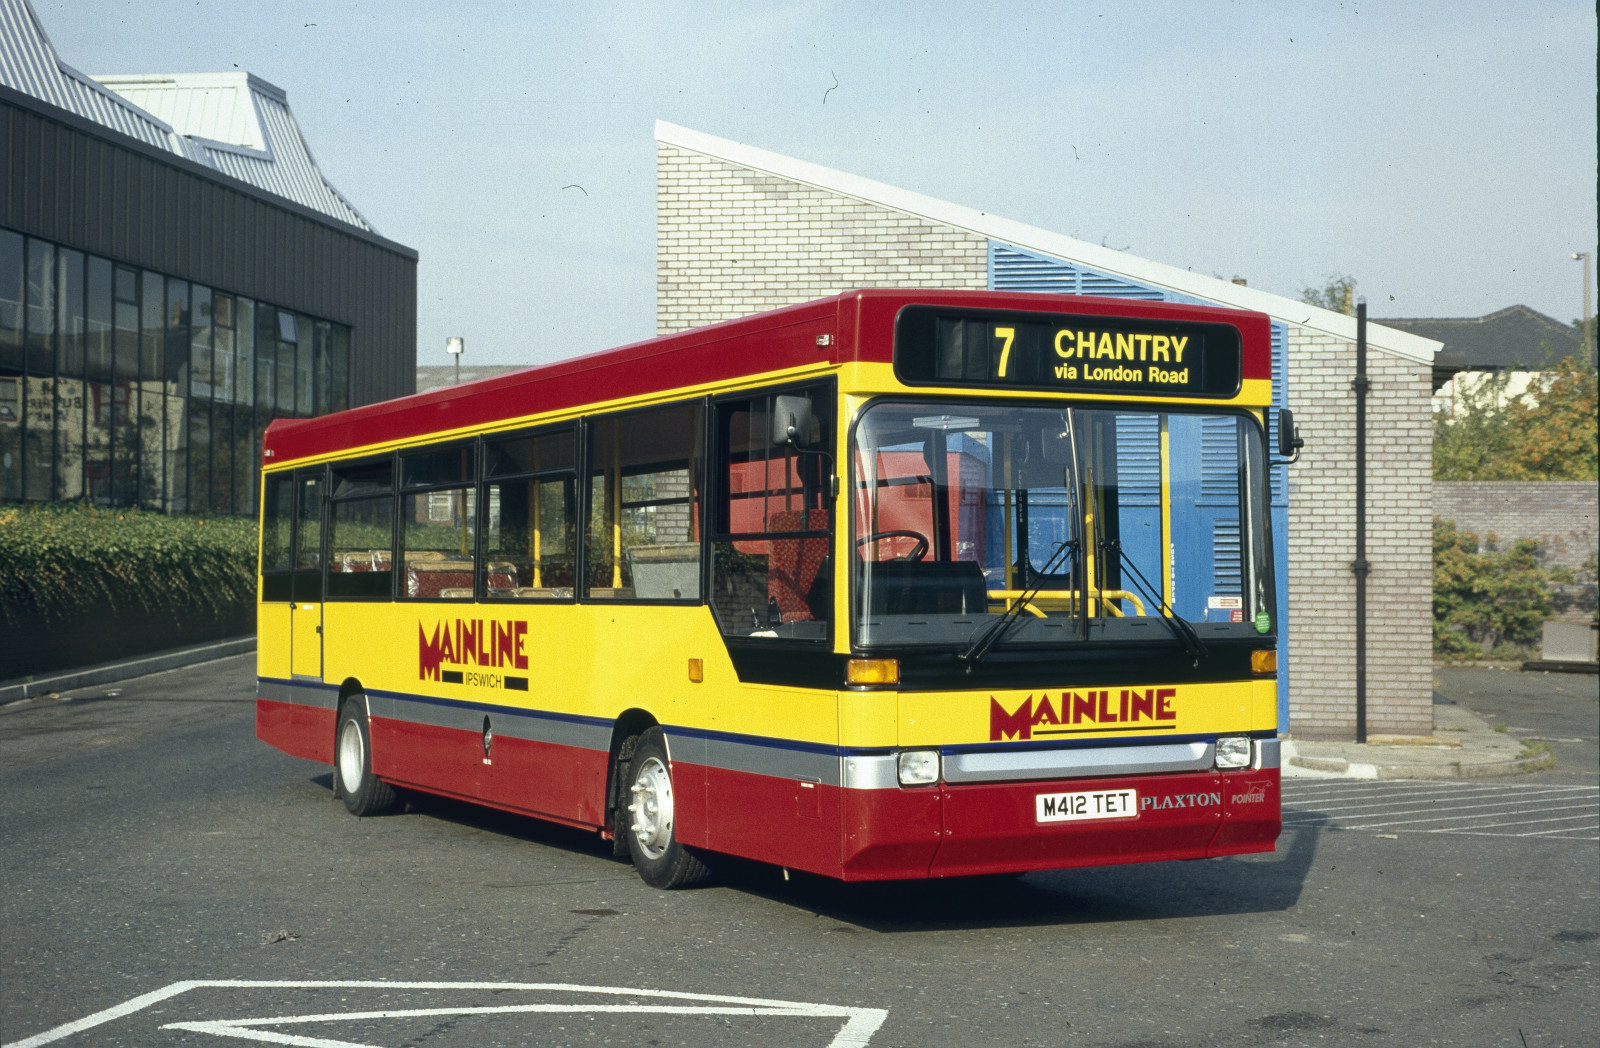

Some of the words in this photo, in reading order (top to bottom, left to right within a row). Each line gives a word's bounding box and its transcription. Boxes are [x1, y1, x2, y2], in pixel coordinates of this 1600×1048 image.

[995, 327, 1015, 377] 7
[1054, 329, 1188, 362] CHANTRY
[1054, 363, 1077, 380] via
[1084, 364, 1142, 382] London
[1149, 366, 1188, 384] Road
[418, 618, 529, 682] MAINLINE
[465, 672, 502, 689] IPSWICH
[990, 688, 1176, 741] MAINLINE
[1044, 795, 1087, 816] M412
[1093, 792, 1130, 813] TET
[1141, 792, 1221, 811] PLAXTON
[1231, 793, 1265, 804] POINTER
